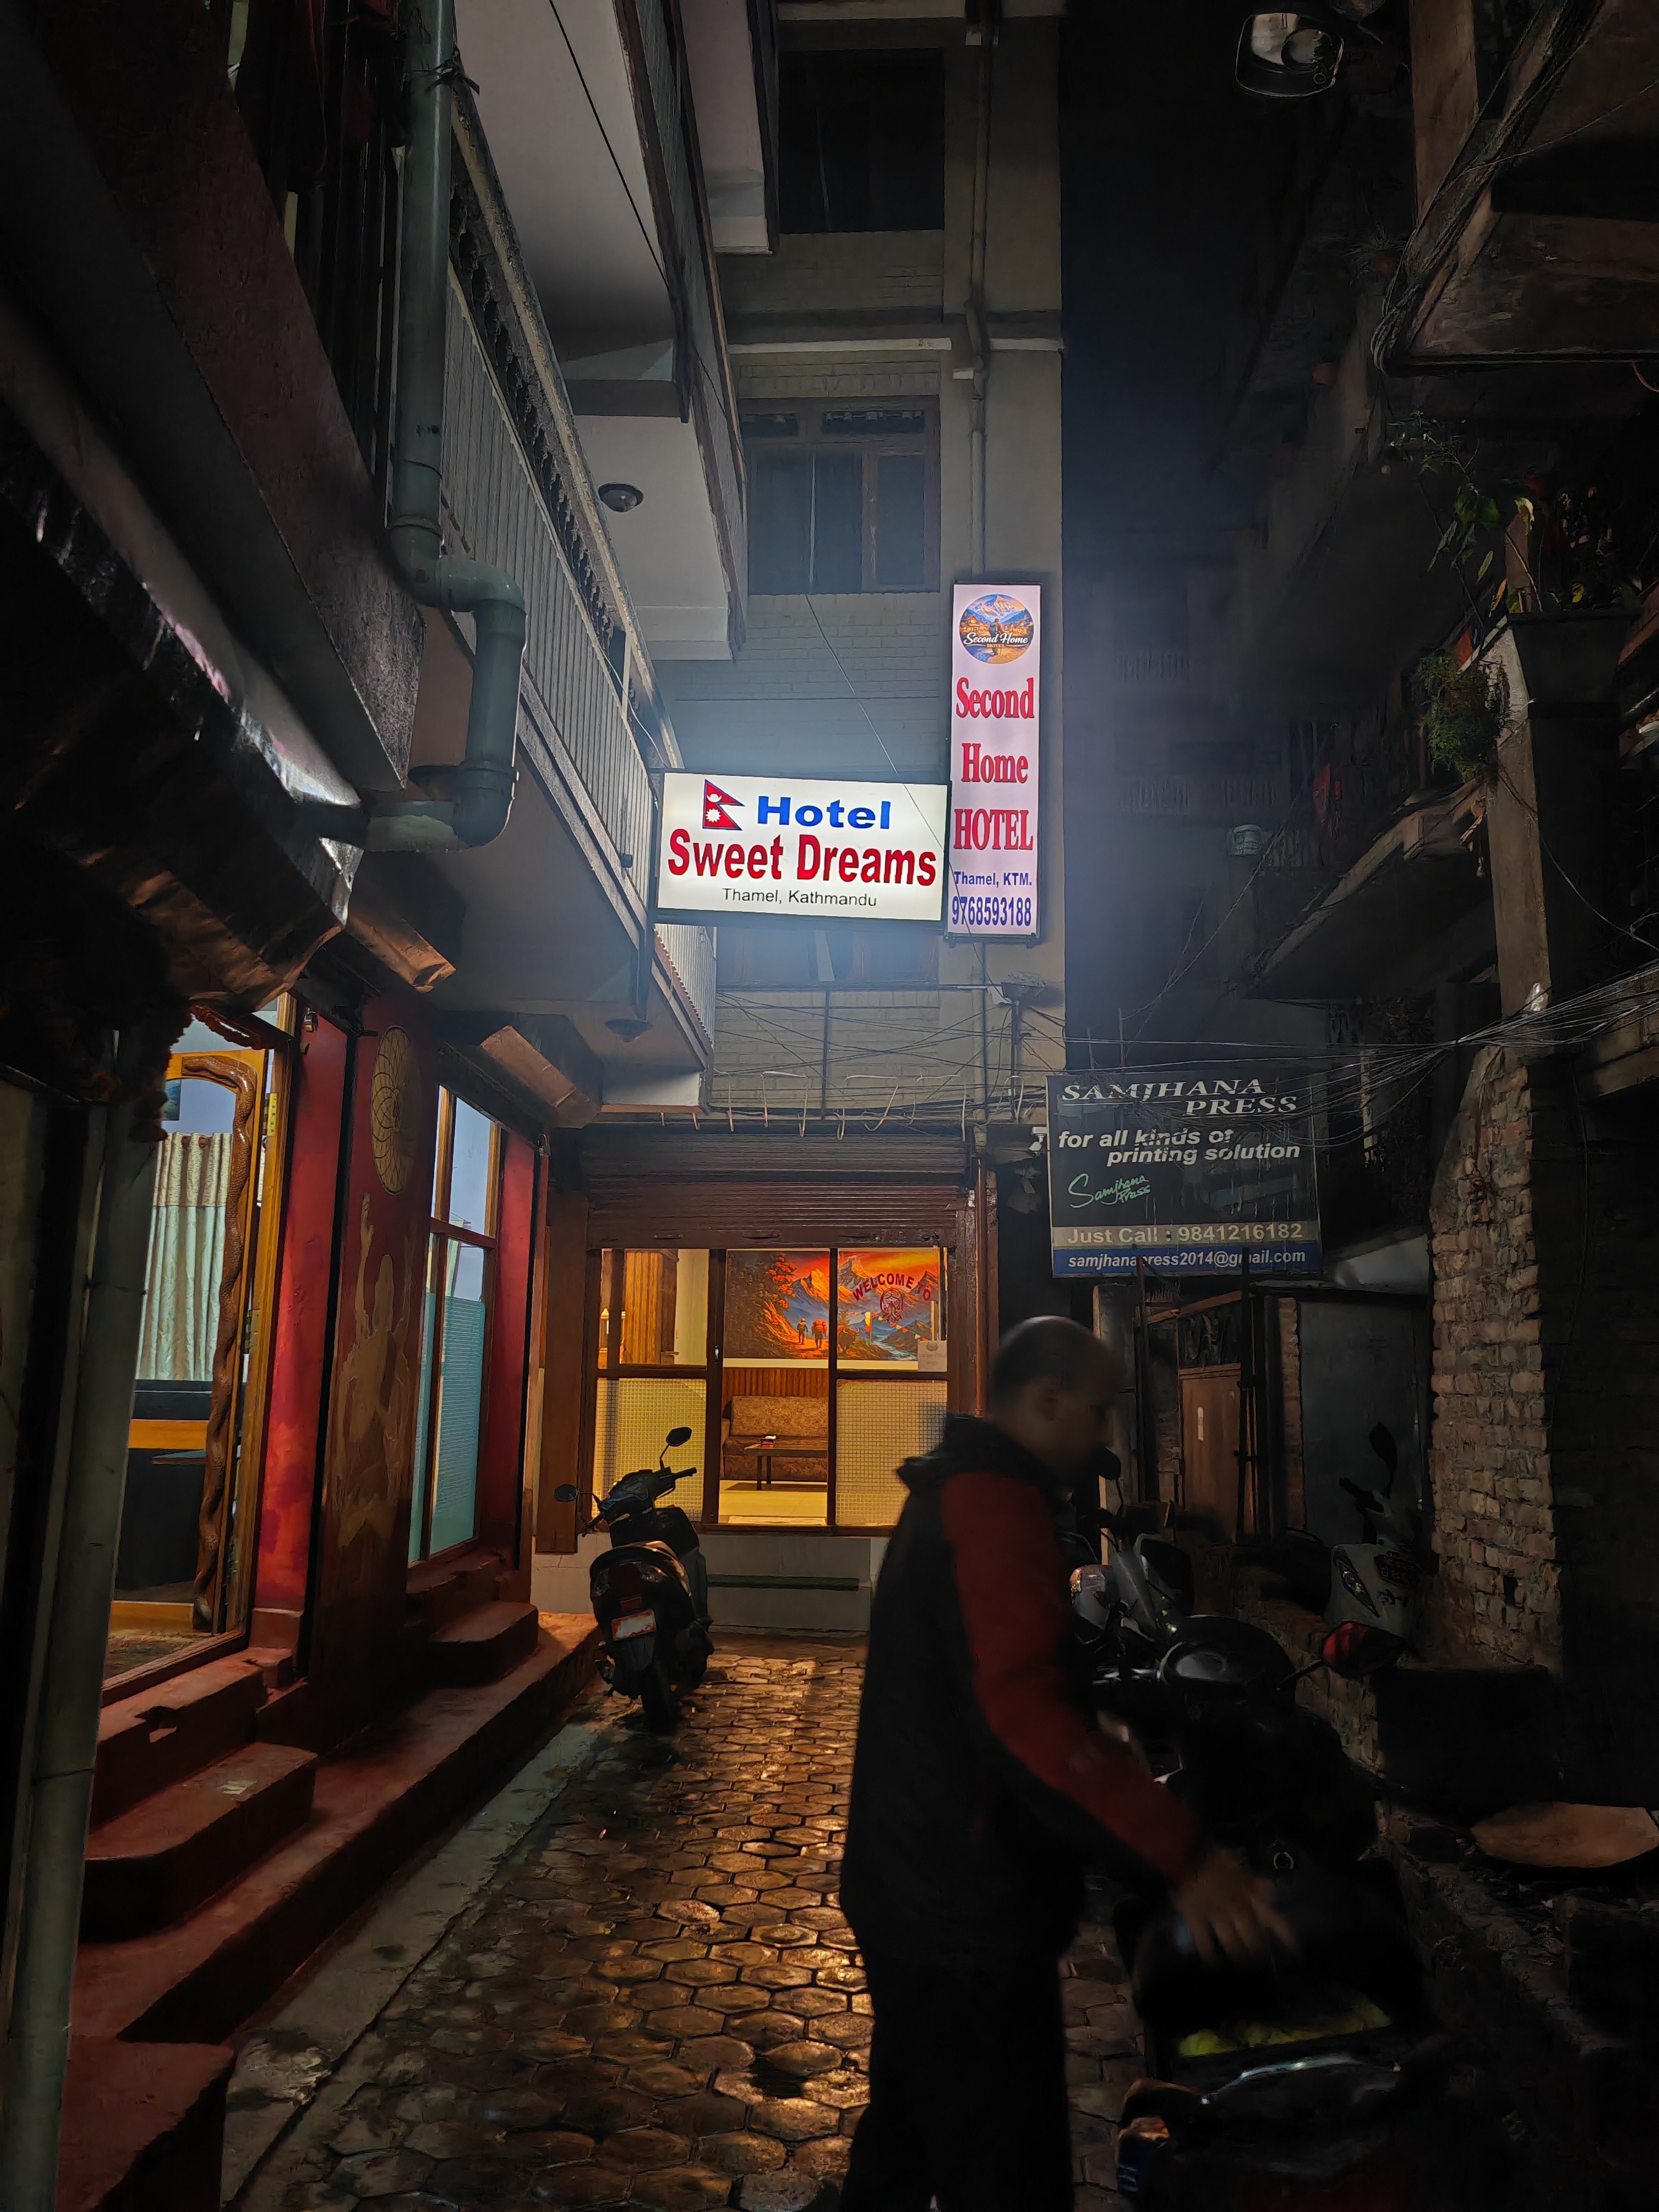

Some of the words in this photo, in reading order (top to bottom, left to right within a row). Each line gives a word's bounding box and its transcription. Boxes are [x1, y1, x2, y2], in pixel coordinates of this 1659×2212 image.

[963, 632, 999, 645] Second
[1000, 632, 1029, 644] Home
[956, 677, 1035, 719] Second
[961, 743, 1028, 784] Home
[758, 795, 891, 830] Hotel
[954, 808, 1034, 851] HOTEL
[668, 828, 783, 880] Sweet
[797, 834, 936, 887] Dreams
[954, 871, 999, 888] Thamel,
[1003, 872, 1032, 886] KTM.
[724, 888, 782, 905] Thamel,
[788, 889, 877, 907] Kathmandu
[952, 896, 1031, 927] 9768593188
[1062, 1079, 1266, 1102] SAMJHANA
[1181, 1096, 1297, 1116] PRESS
[1058, 1131, 1093, 1148] for
[1099, 1130, 1128, 1148] all
[1135, 1128, 1200, 1147] kinds
[1107, 1147, 1198, 1167] printing
[1204, 1143, 1300, 1160] solution
[1068, 1173, 1149, 1208] Samjhana
[1068, 1228, 1113, 1244] Just
[1119, 1227, 1158, 1243] Call
[1178, 1223, 1303, 1242] 9841216182
[853, 1273, 915, 1301] WELCOME
[916, 1281, 931, 1301] TO
